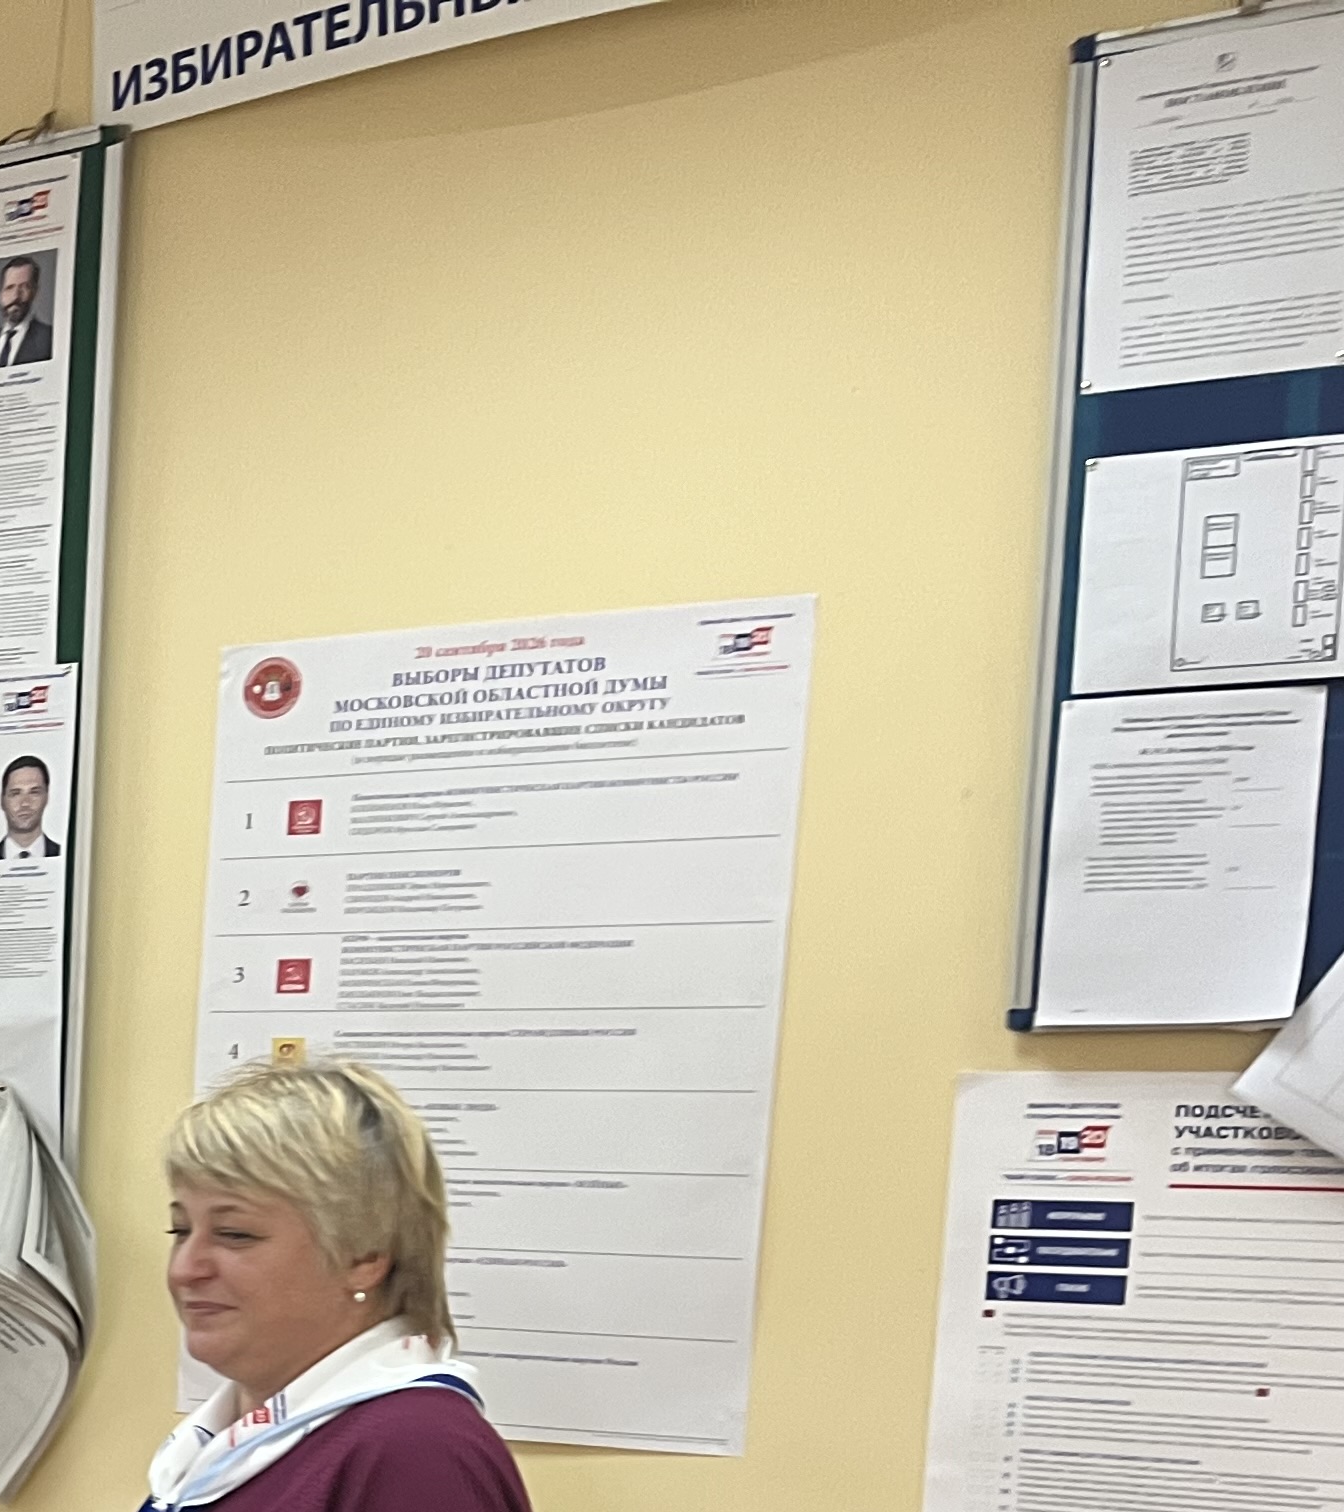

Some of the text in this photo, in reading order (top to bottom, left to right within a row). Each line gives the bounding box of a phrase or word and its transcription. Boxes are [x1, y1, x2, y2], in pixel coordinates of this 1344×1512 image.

[392, 657, 607, 687] ВЫБОРЫ ДЕПУТАТОВ
[333, 675, 668, 713] МОСКОВСКОЙ ОБЛАСТНОЙ ДУМЫ
[329, 697, 672, 733] ПО ЕДИНОМУ ИЗБИРАТЕЛЬНОМУ ОКРУГУ
[245, 813, 252, 829] 1
[238, 889, 251, 906] 2
[232, 966, 245, 983] 3
[228, 1043, 238, 1059] 4
[1175, 1104, 1272, 1119] ПОДСЧЕ
